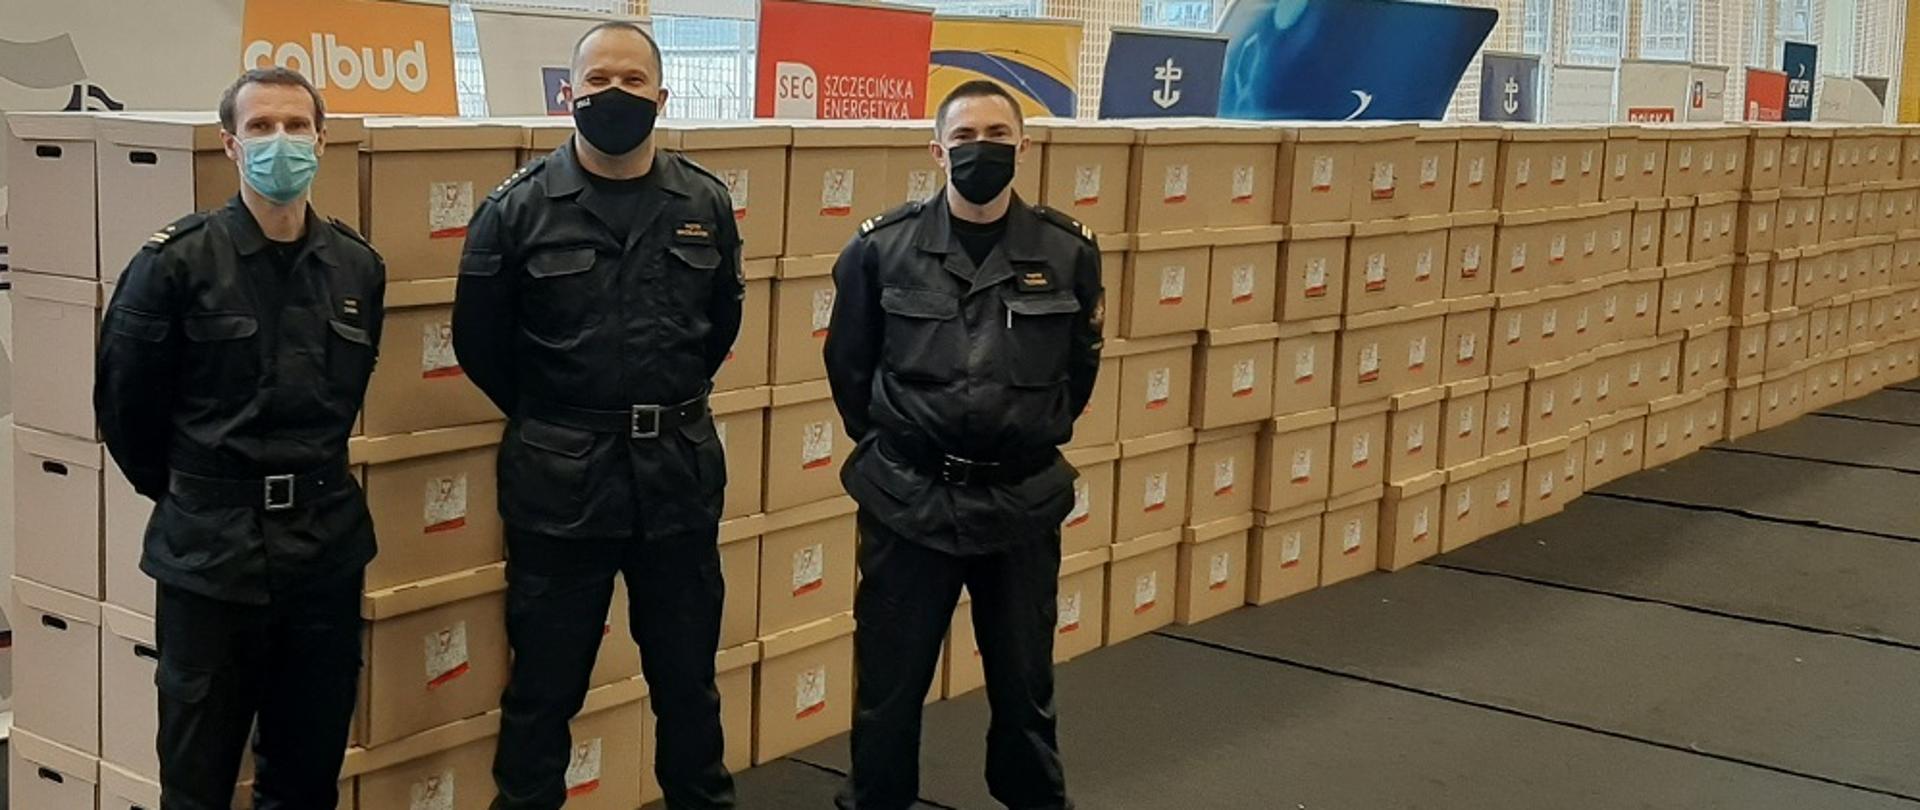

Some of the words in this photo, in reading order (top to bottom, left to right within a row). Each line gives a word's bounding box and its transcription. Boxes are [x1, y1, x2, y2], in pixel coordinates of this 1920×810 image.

[244, 33, 428, 93] calbud
[779, 74, 814, 99] SEC
[824, 74, 914, 99] SZCZECIŃSKA
[824, 98, 910, 119] ENERGETYKA
